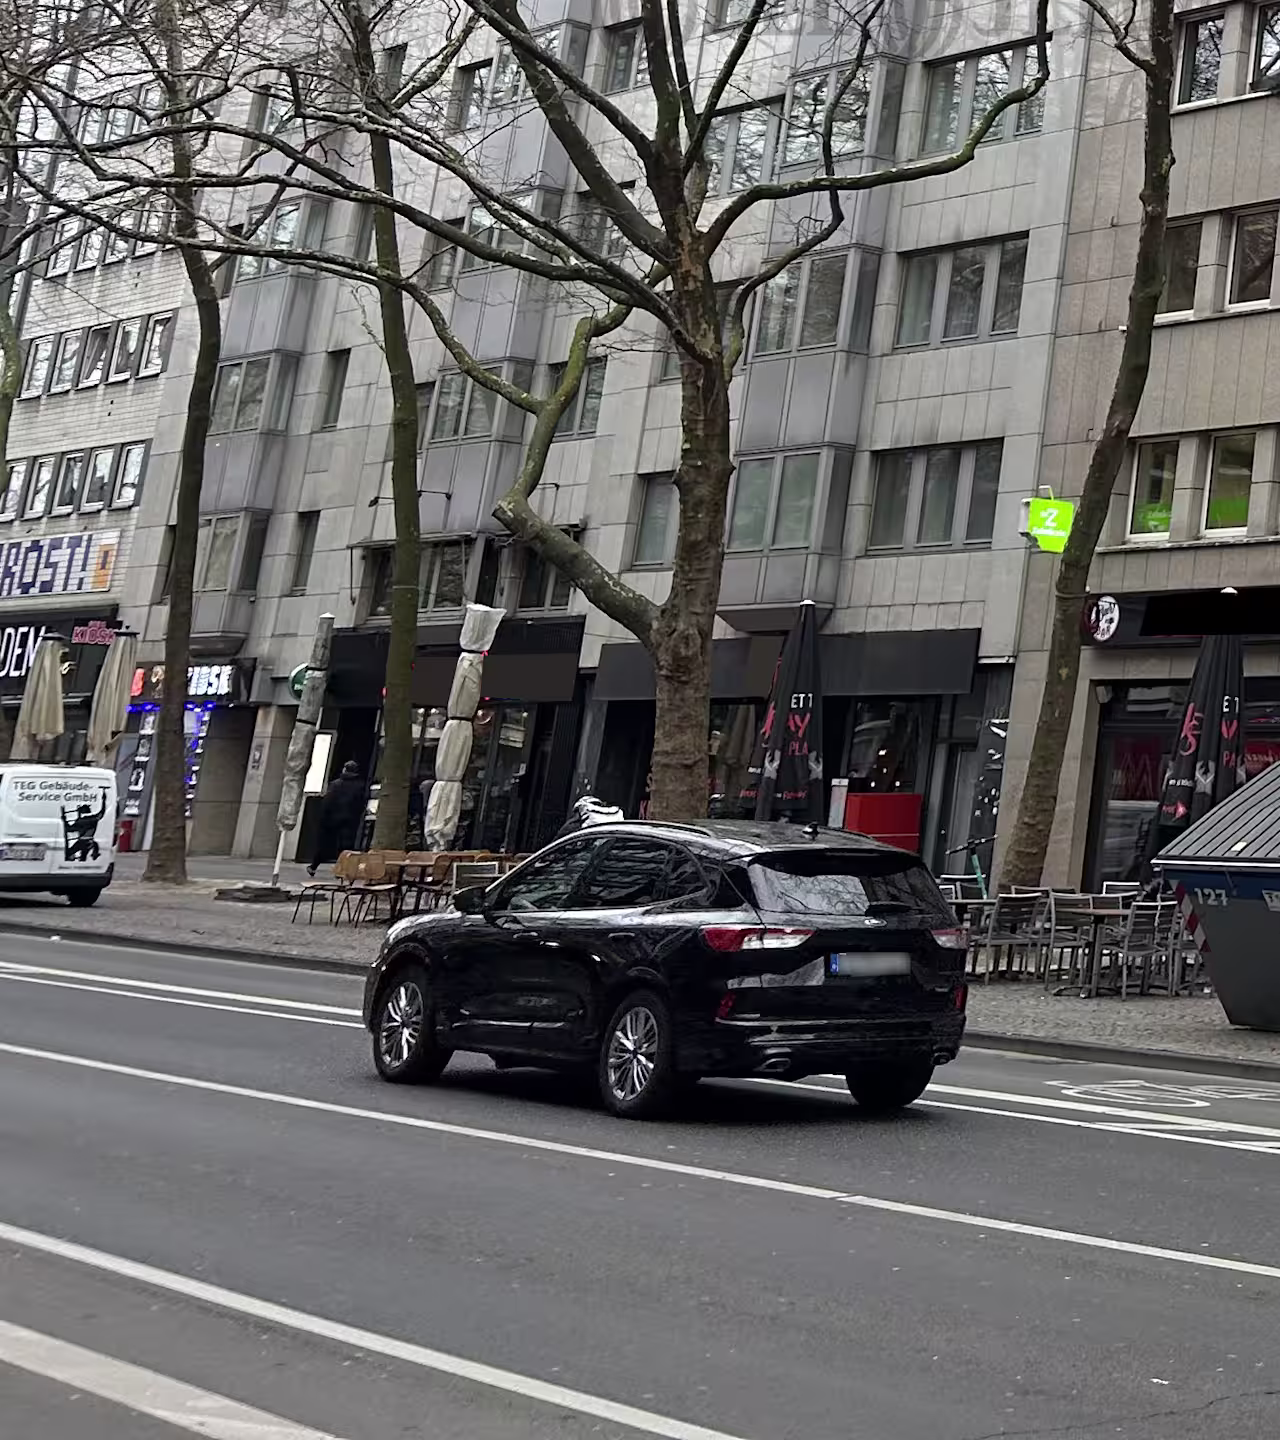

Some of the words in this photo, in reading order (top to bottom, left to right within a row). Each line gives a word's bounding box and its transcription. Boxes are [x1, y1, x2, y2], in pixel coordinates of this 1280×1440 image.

[13, 781, 36, 790] TEG
[18, 792, 61, 801] Service
[64, 792, 98, 802] GmbH
[1193, 887, 1228, 907] 127
